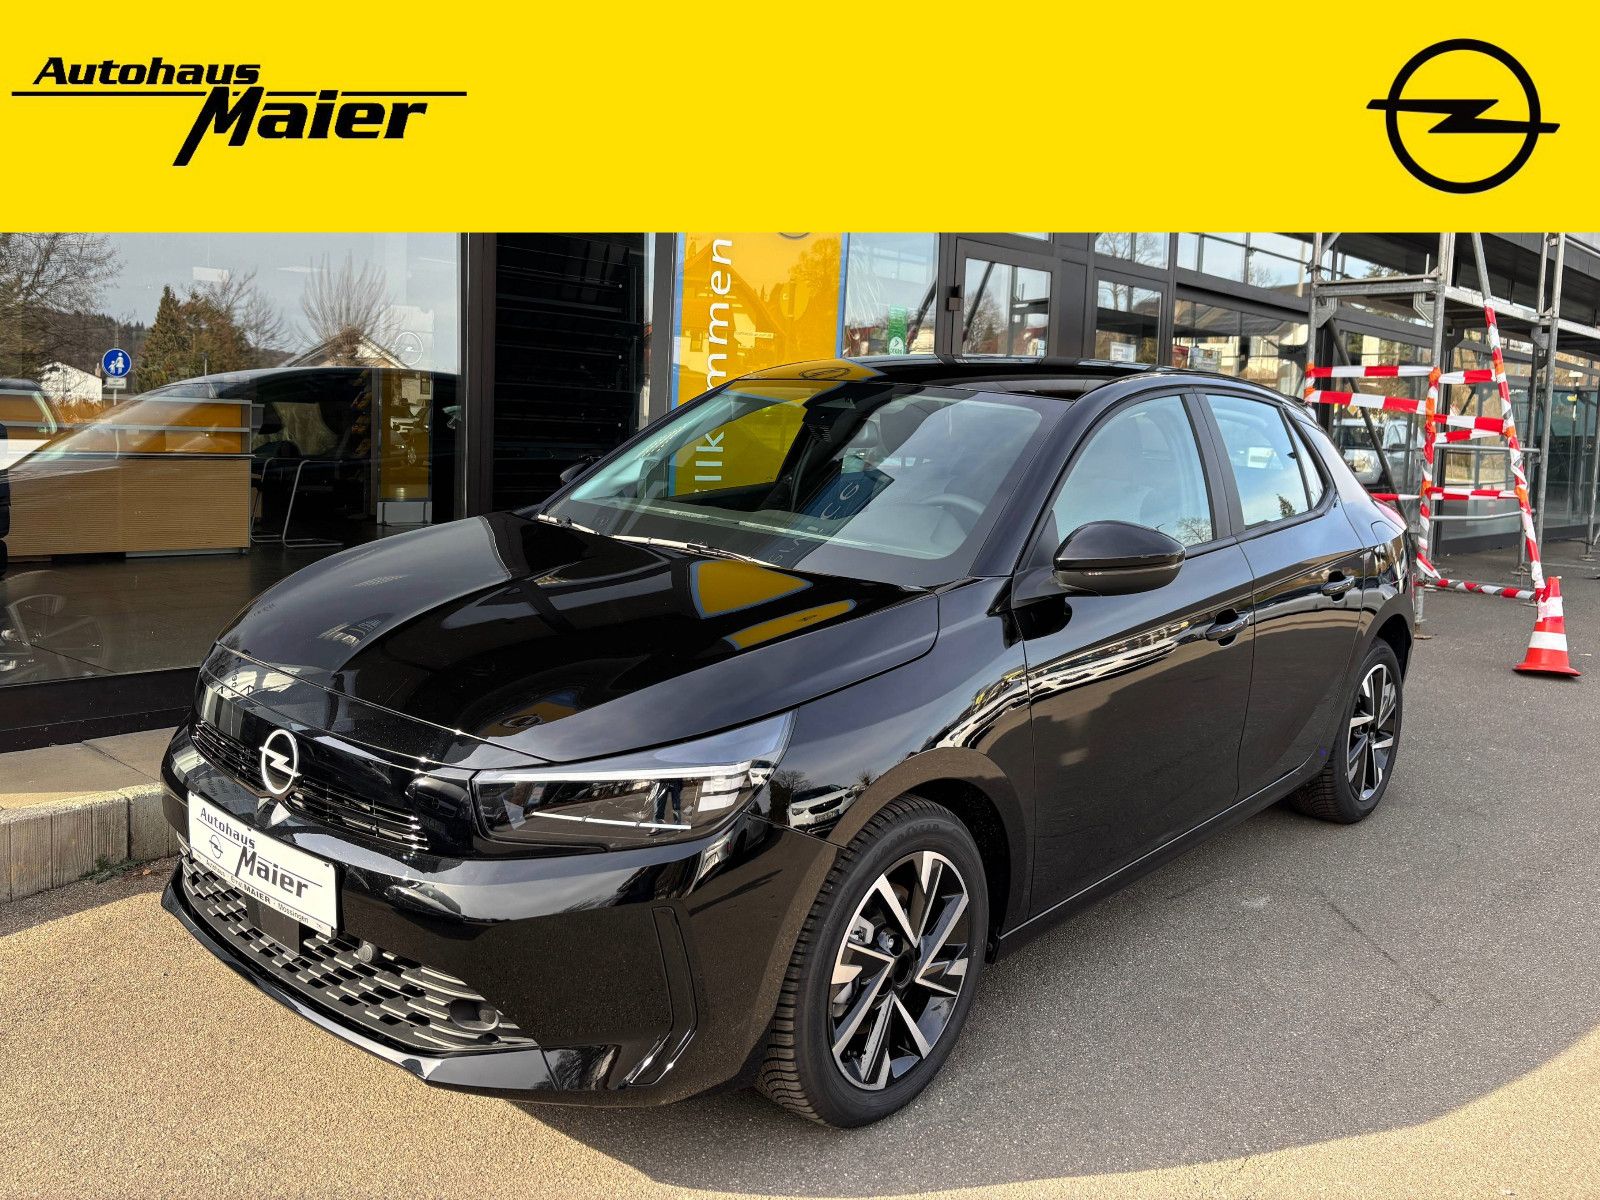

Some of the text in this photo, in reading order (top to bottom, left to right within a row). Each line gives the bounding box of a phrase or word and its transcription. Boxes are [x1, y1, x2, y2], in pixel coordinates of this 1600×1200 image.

[200, 807, 255, 849] Autohaus
[235, 845, 309, 898] Maier
[243, 883, 271, 905] MAIER
